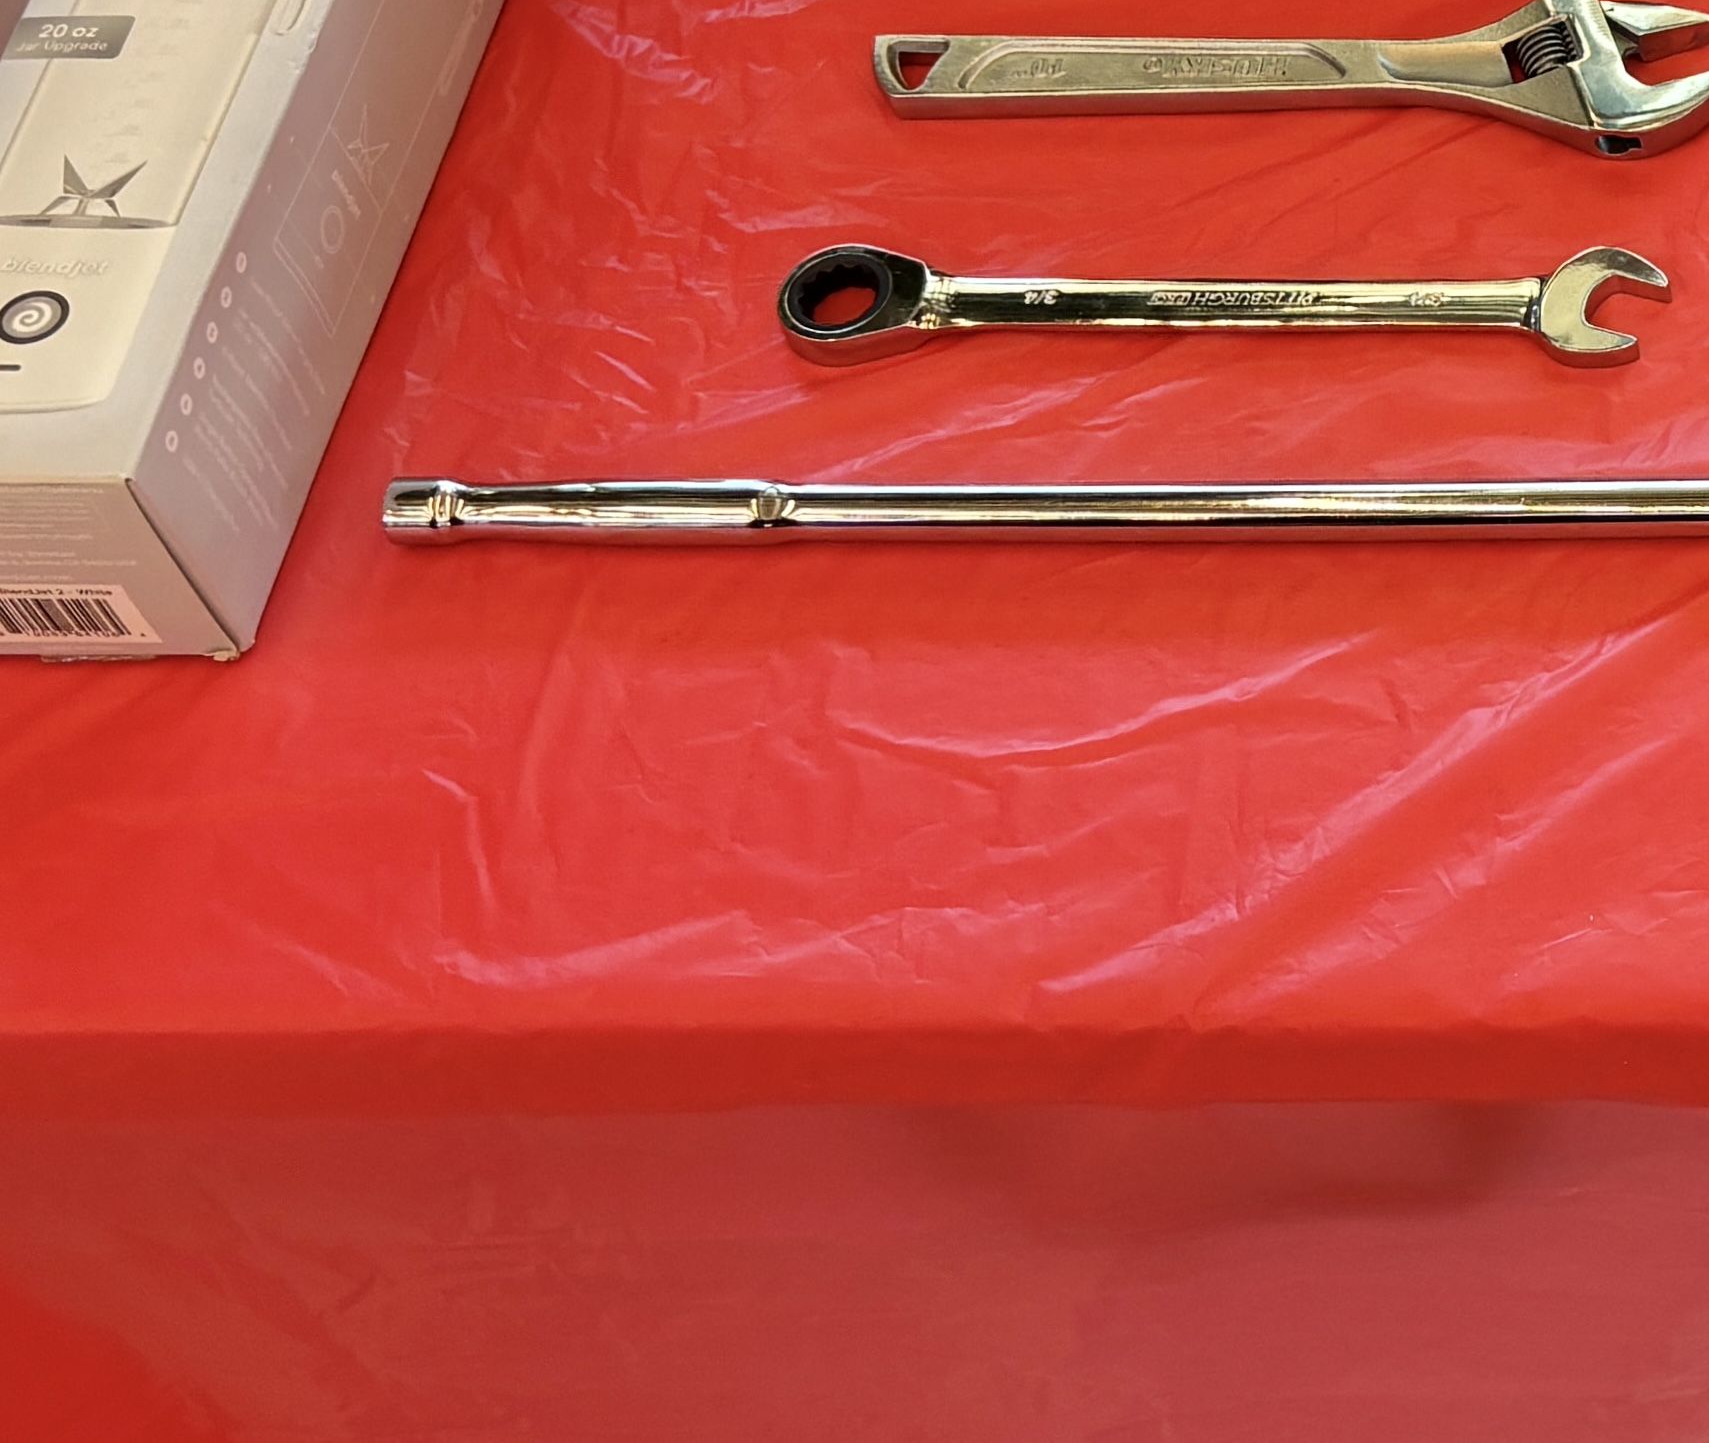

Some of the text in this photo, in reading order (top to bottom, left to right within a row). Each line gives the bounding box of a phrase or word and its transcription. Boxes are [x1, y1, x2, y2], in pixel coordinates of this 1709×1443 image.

[38, 23, 99, 38] 20 oz
[43, 39, 108, 54] Upgrade
[1188, 290, 1317, 307] PITTSBURGH
